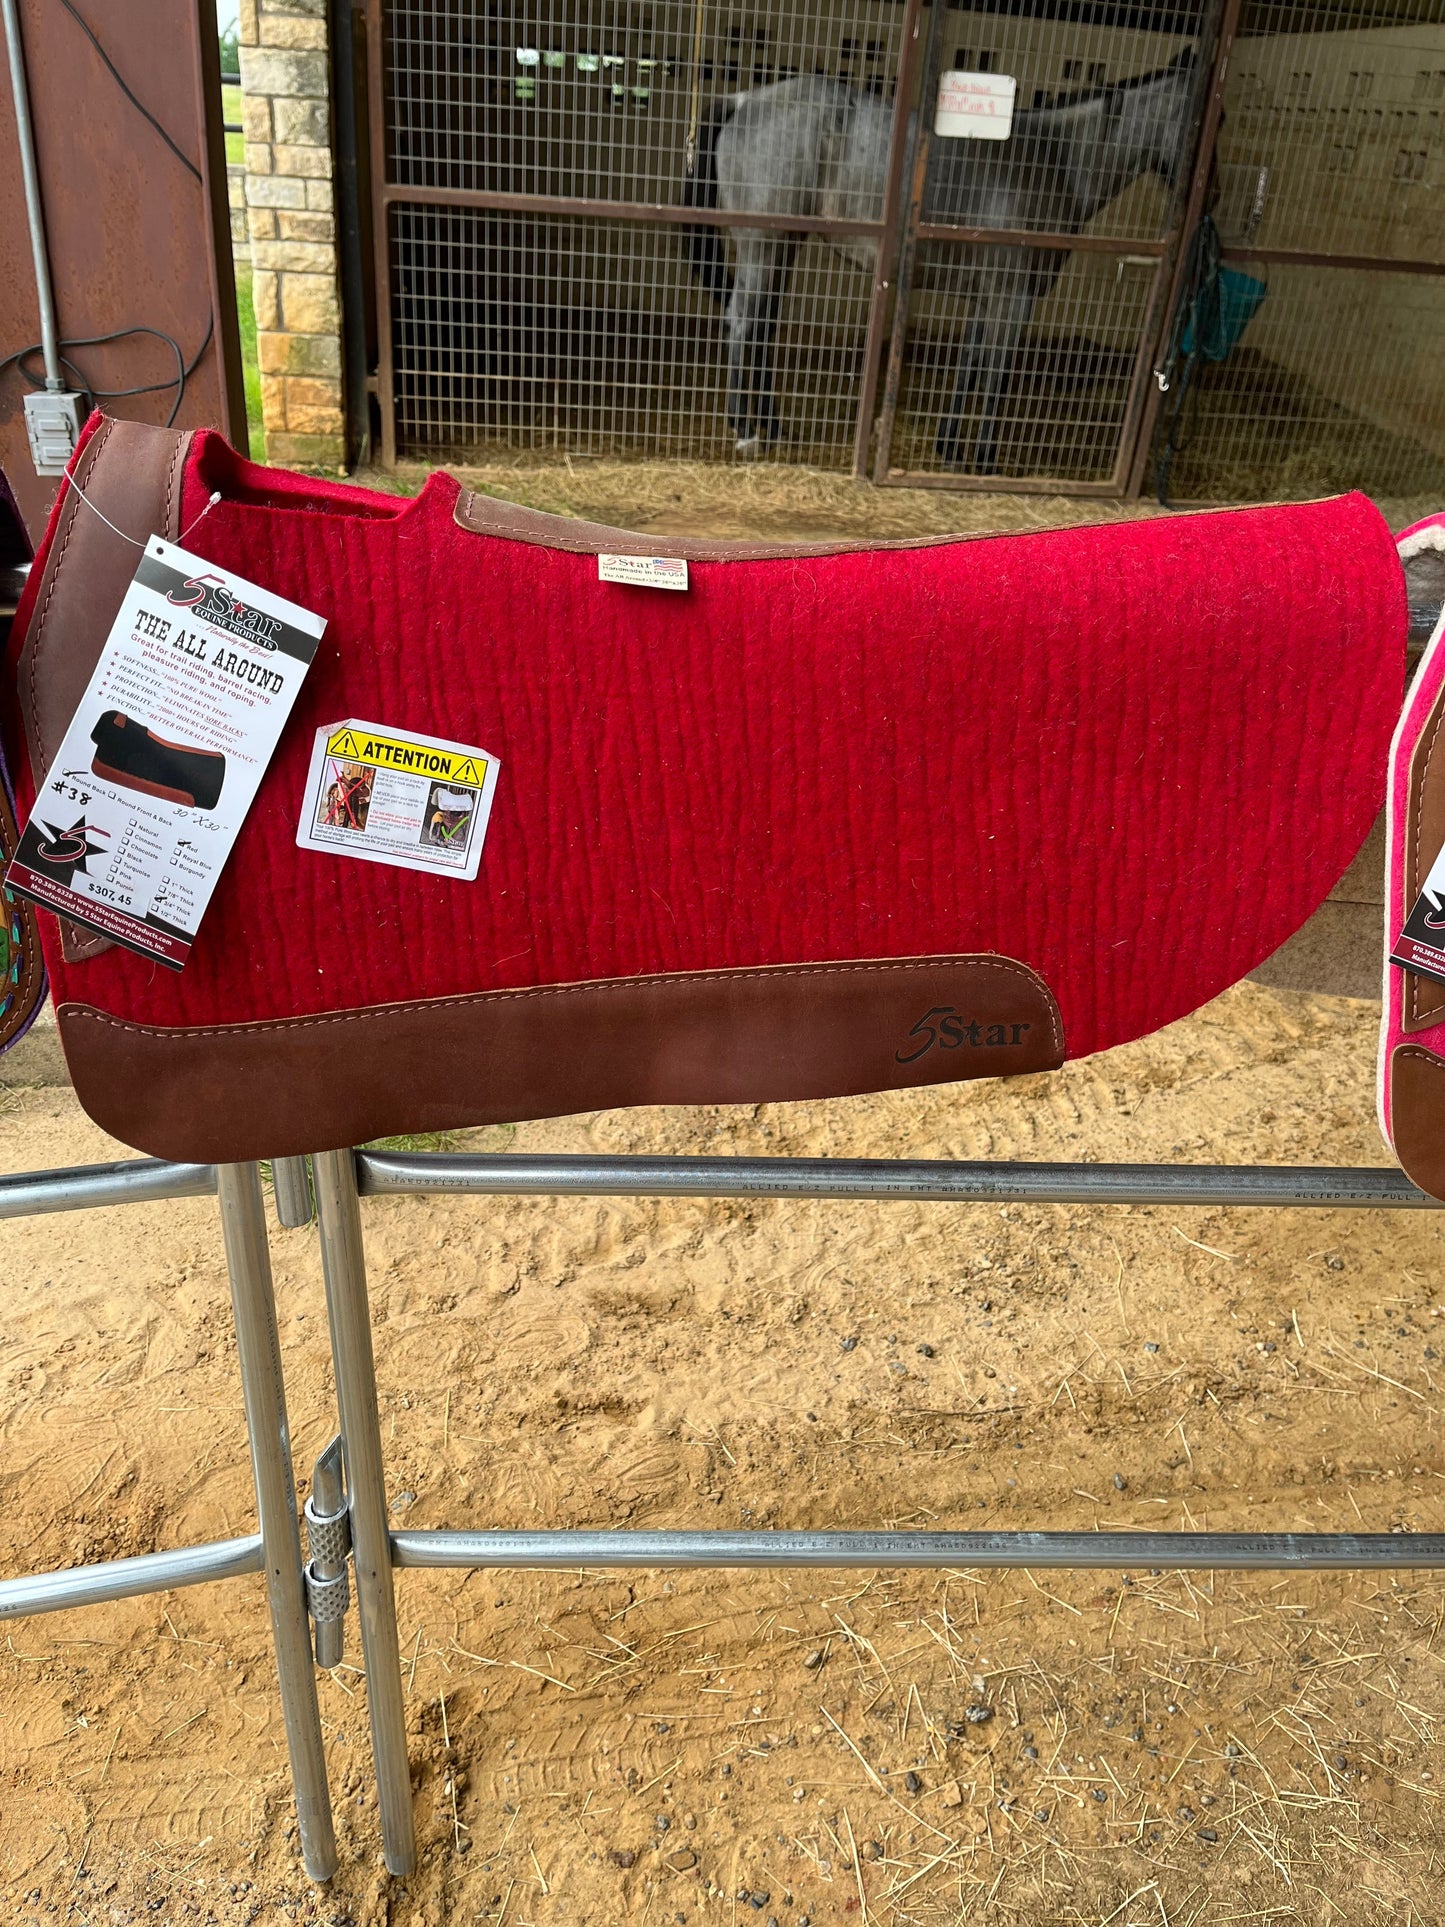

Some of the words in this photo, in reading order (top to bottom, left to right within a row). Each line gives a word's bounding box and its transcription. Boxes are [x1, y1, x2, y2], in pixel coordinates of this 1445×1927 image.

[208, 587, 282, 642] Star
[194, 605, 228, 628] EQUINE
[227, 621, 274, 650] PRODUCTS
[132, 608, 172, 642] THE
[171, 627, 211, 661] ALL
[210, 645, 285, 696] AROUND
[237, 639, 250, 650] the
[248, 644, 273, 662] Best!
[129, 632, 154, 649] Great
[155, 644, 169, 656] for
[169, 650, 188, 664] trail
[187, 659, 216, 680] riding,
[217, 673, 243, 691] barrel
[118, 664, 150, 683] PERFECT
[141, 647, 180, 672] pleasure
[180, 666, 208, 686] riding,
[208, 679, 226, 693] and
[226, 689, 256, 709] roping.
[180, 680, 198, 693] PURE
[176, 712, 199, 728] HOURS
[199, 723, 210, 732] OF
[175, 723, 206, 742] OVERALL
[362, 740, 452, 774] ATTENTION
[50, 776, 93, 807] #38
[71, 774, 91, 788] Round
[91, 784, 106, 795] Back
[116, 796, 136, 810] Round
[136, 806, 153, 817] Front
[158, 816, 172, 826] Back
[137, 824, 159, 838] Natural
[130, 843, 158, 860] Chocolate
[134, 833, 162, 851] Cinnamon
[186, 844, 198, 853] Red
[126, 852, 142, 863] Black
[182, 853, 199, 865] Royal
[199, 861, 212, 870] Blue
[119, 871, 132, 880] Pink
[122, 861, 151, 879] Turquoise
[178, 862, 206, 880] Burgundy
[178, 885, 193, 895] Thick
[29, 874, 73, 899] 870.389.6328
[76, 897, 172, 947] www.5StarEquineProducts.com
[175, 905, 191, 916] Thick
[179, 896, 194, 907] Thick
[29, 883, 76, 910] Manufactured
[74, 905, 84, 914] by
[89, 912, 102, 922] Star
[102, 918, 125, 934] Equine
[124, 928, 154, 947] Products,
[154, 942, 166, 952] Inc.
[171, 915, 187, 926] Thick
